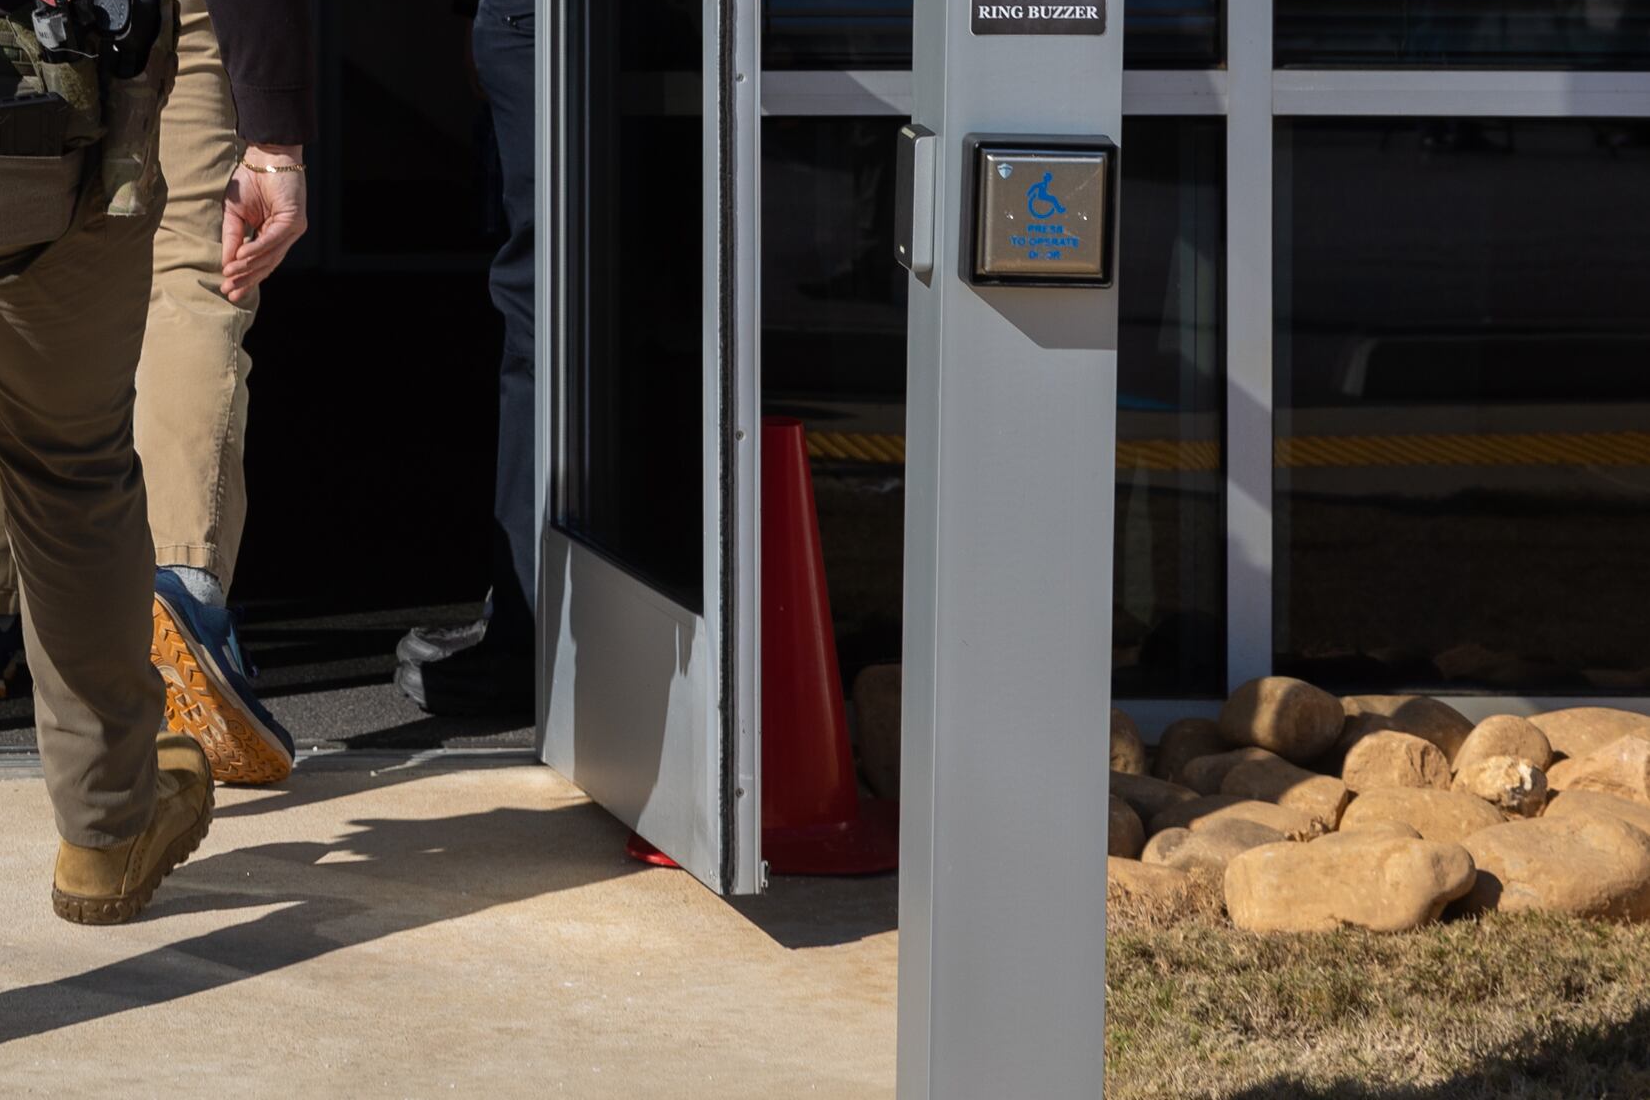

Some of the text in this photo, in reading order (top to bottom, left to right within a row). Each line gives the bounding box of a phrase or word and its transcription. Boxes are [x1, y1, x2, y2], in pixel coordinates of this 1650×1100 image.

[978, 5, 1099, 19] RING BUZZER
[1011, 235, 1026, 246] TO
